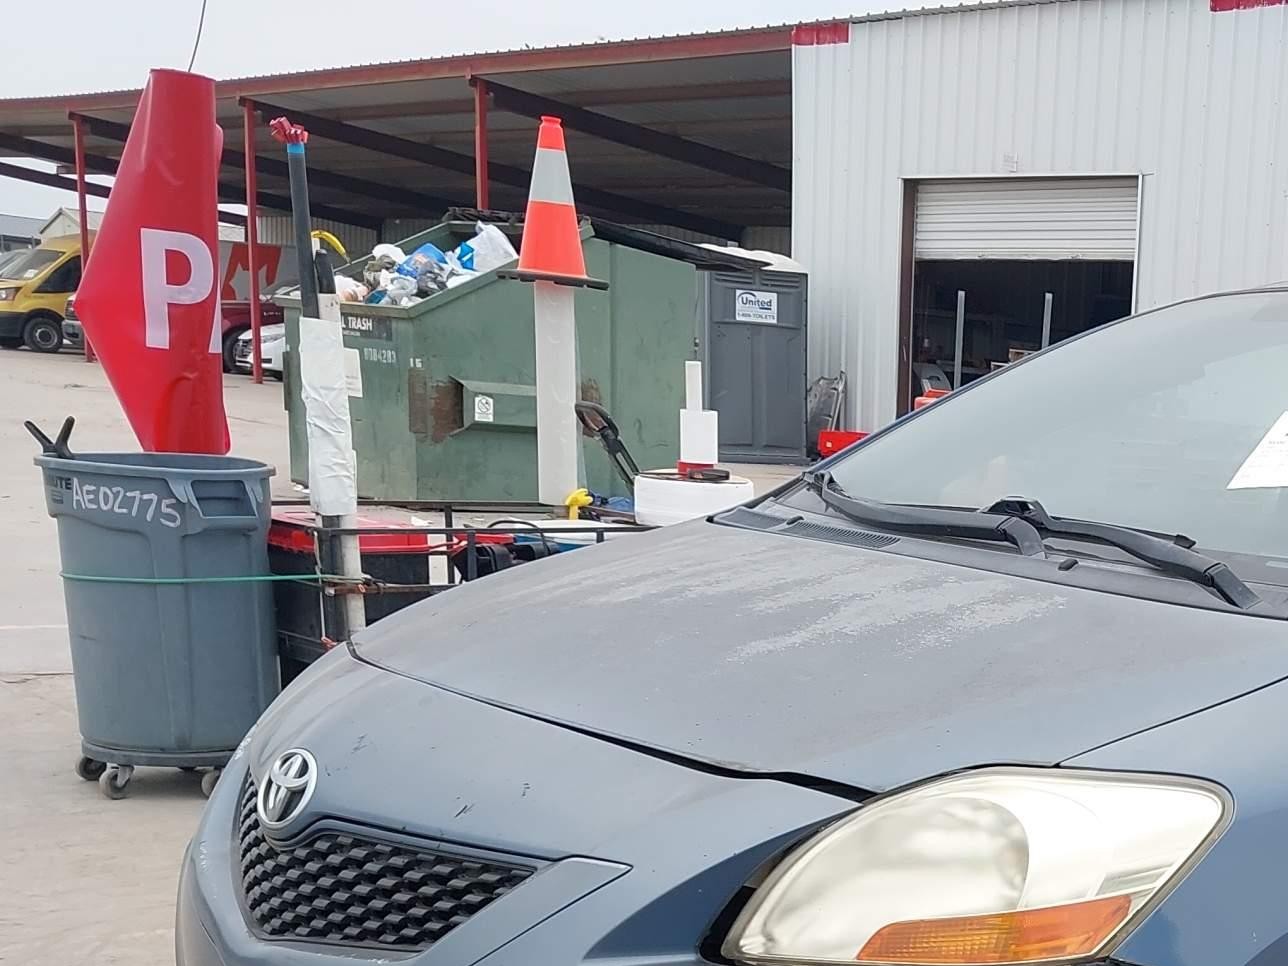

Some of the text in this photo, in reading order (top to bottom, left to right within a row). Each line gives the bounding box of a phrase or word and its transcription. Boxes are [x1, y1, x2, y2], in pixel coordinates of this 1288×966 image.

[741, 296, 772, 307] United
[347, 316, 373, 332] TRASH
[72, 477, 181, 527] AE02775
